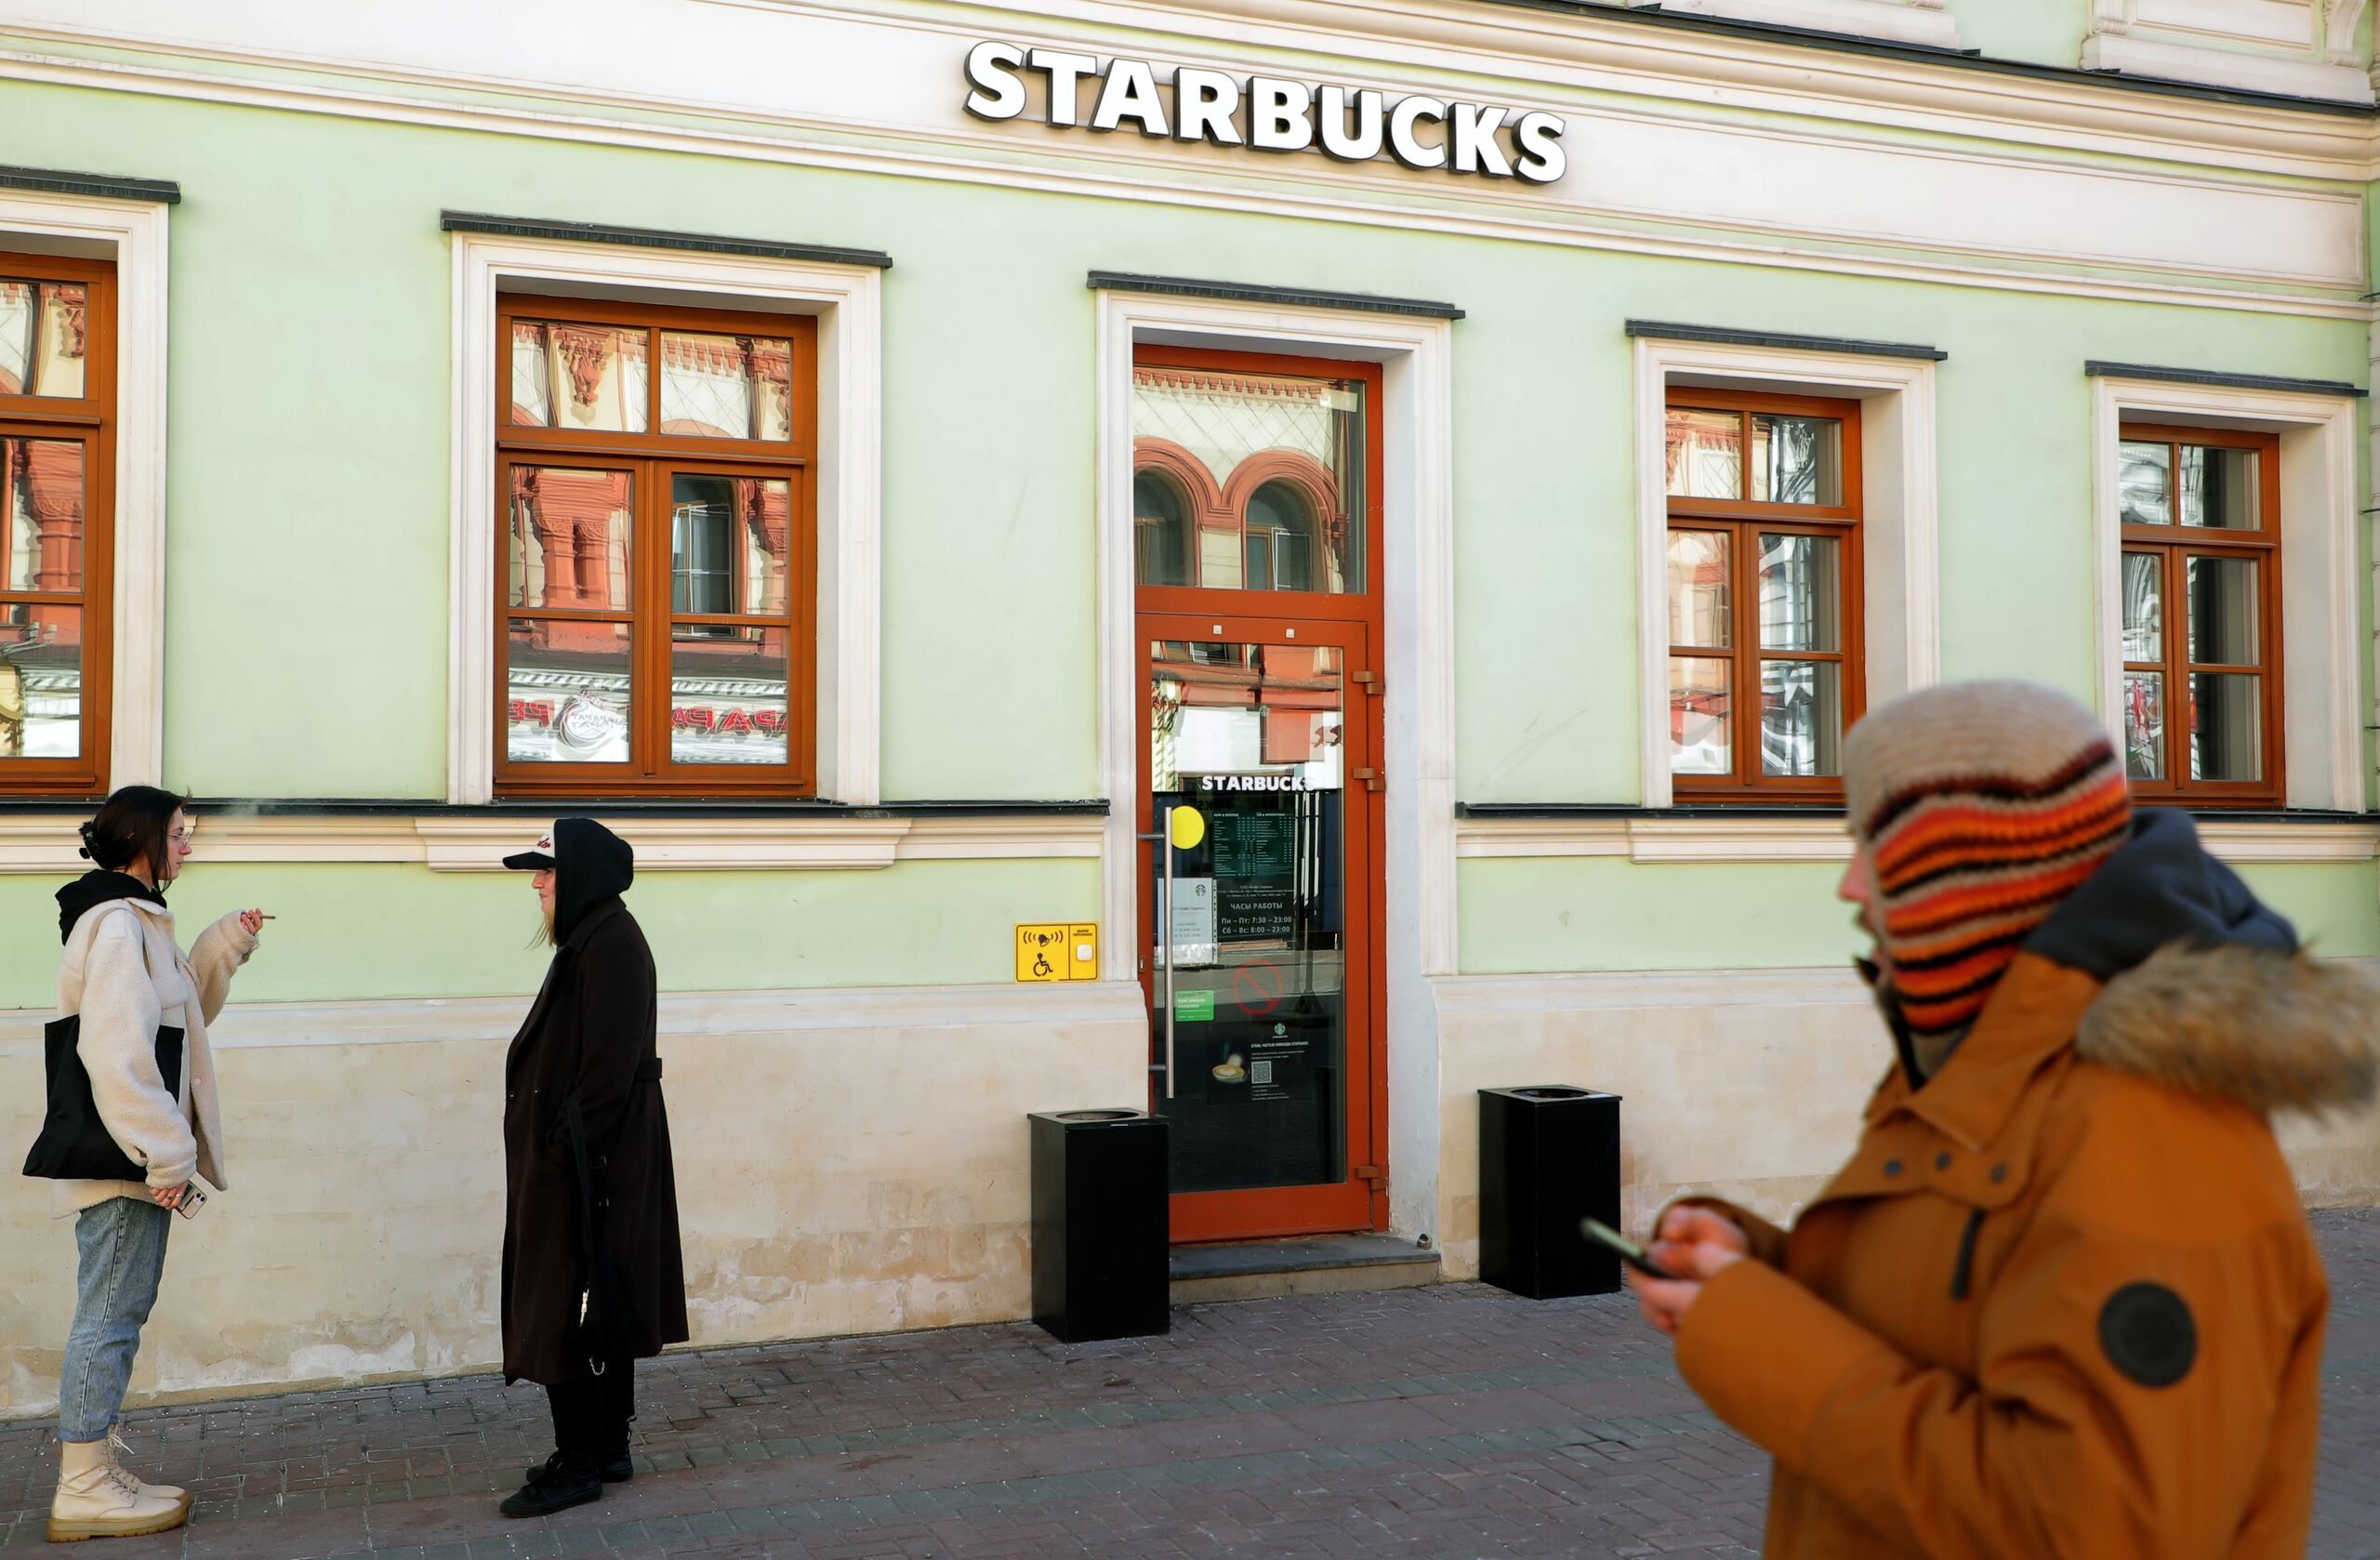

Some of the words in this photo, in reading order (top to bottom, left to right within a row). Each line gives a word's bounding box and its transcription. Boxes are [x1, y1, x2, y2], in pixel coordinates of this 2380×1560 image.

[964, 41, 1567, 186] STARBUCKS
[1201, 775, 1316, 792] STARBUCKS
[1252, 902, 1283, 910] РАБОТЫ
